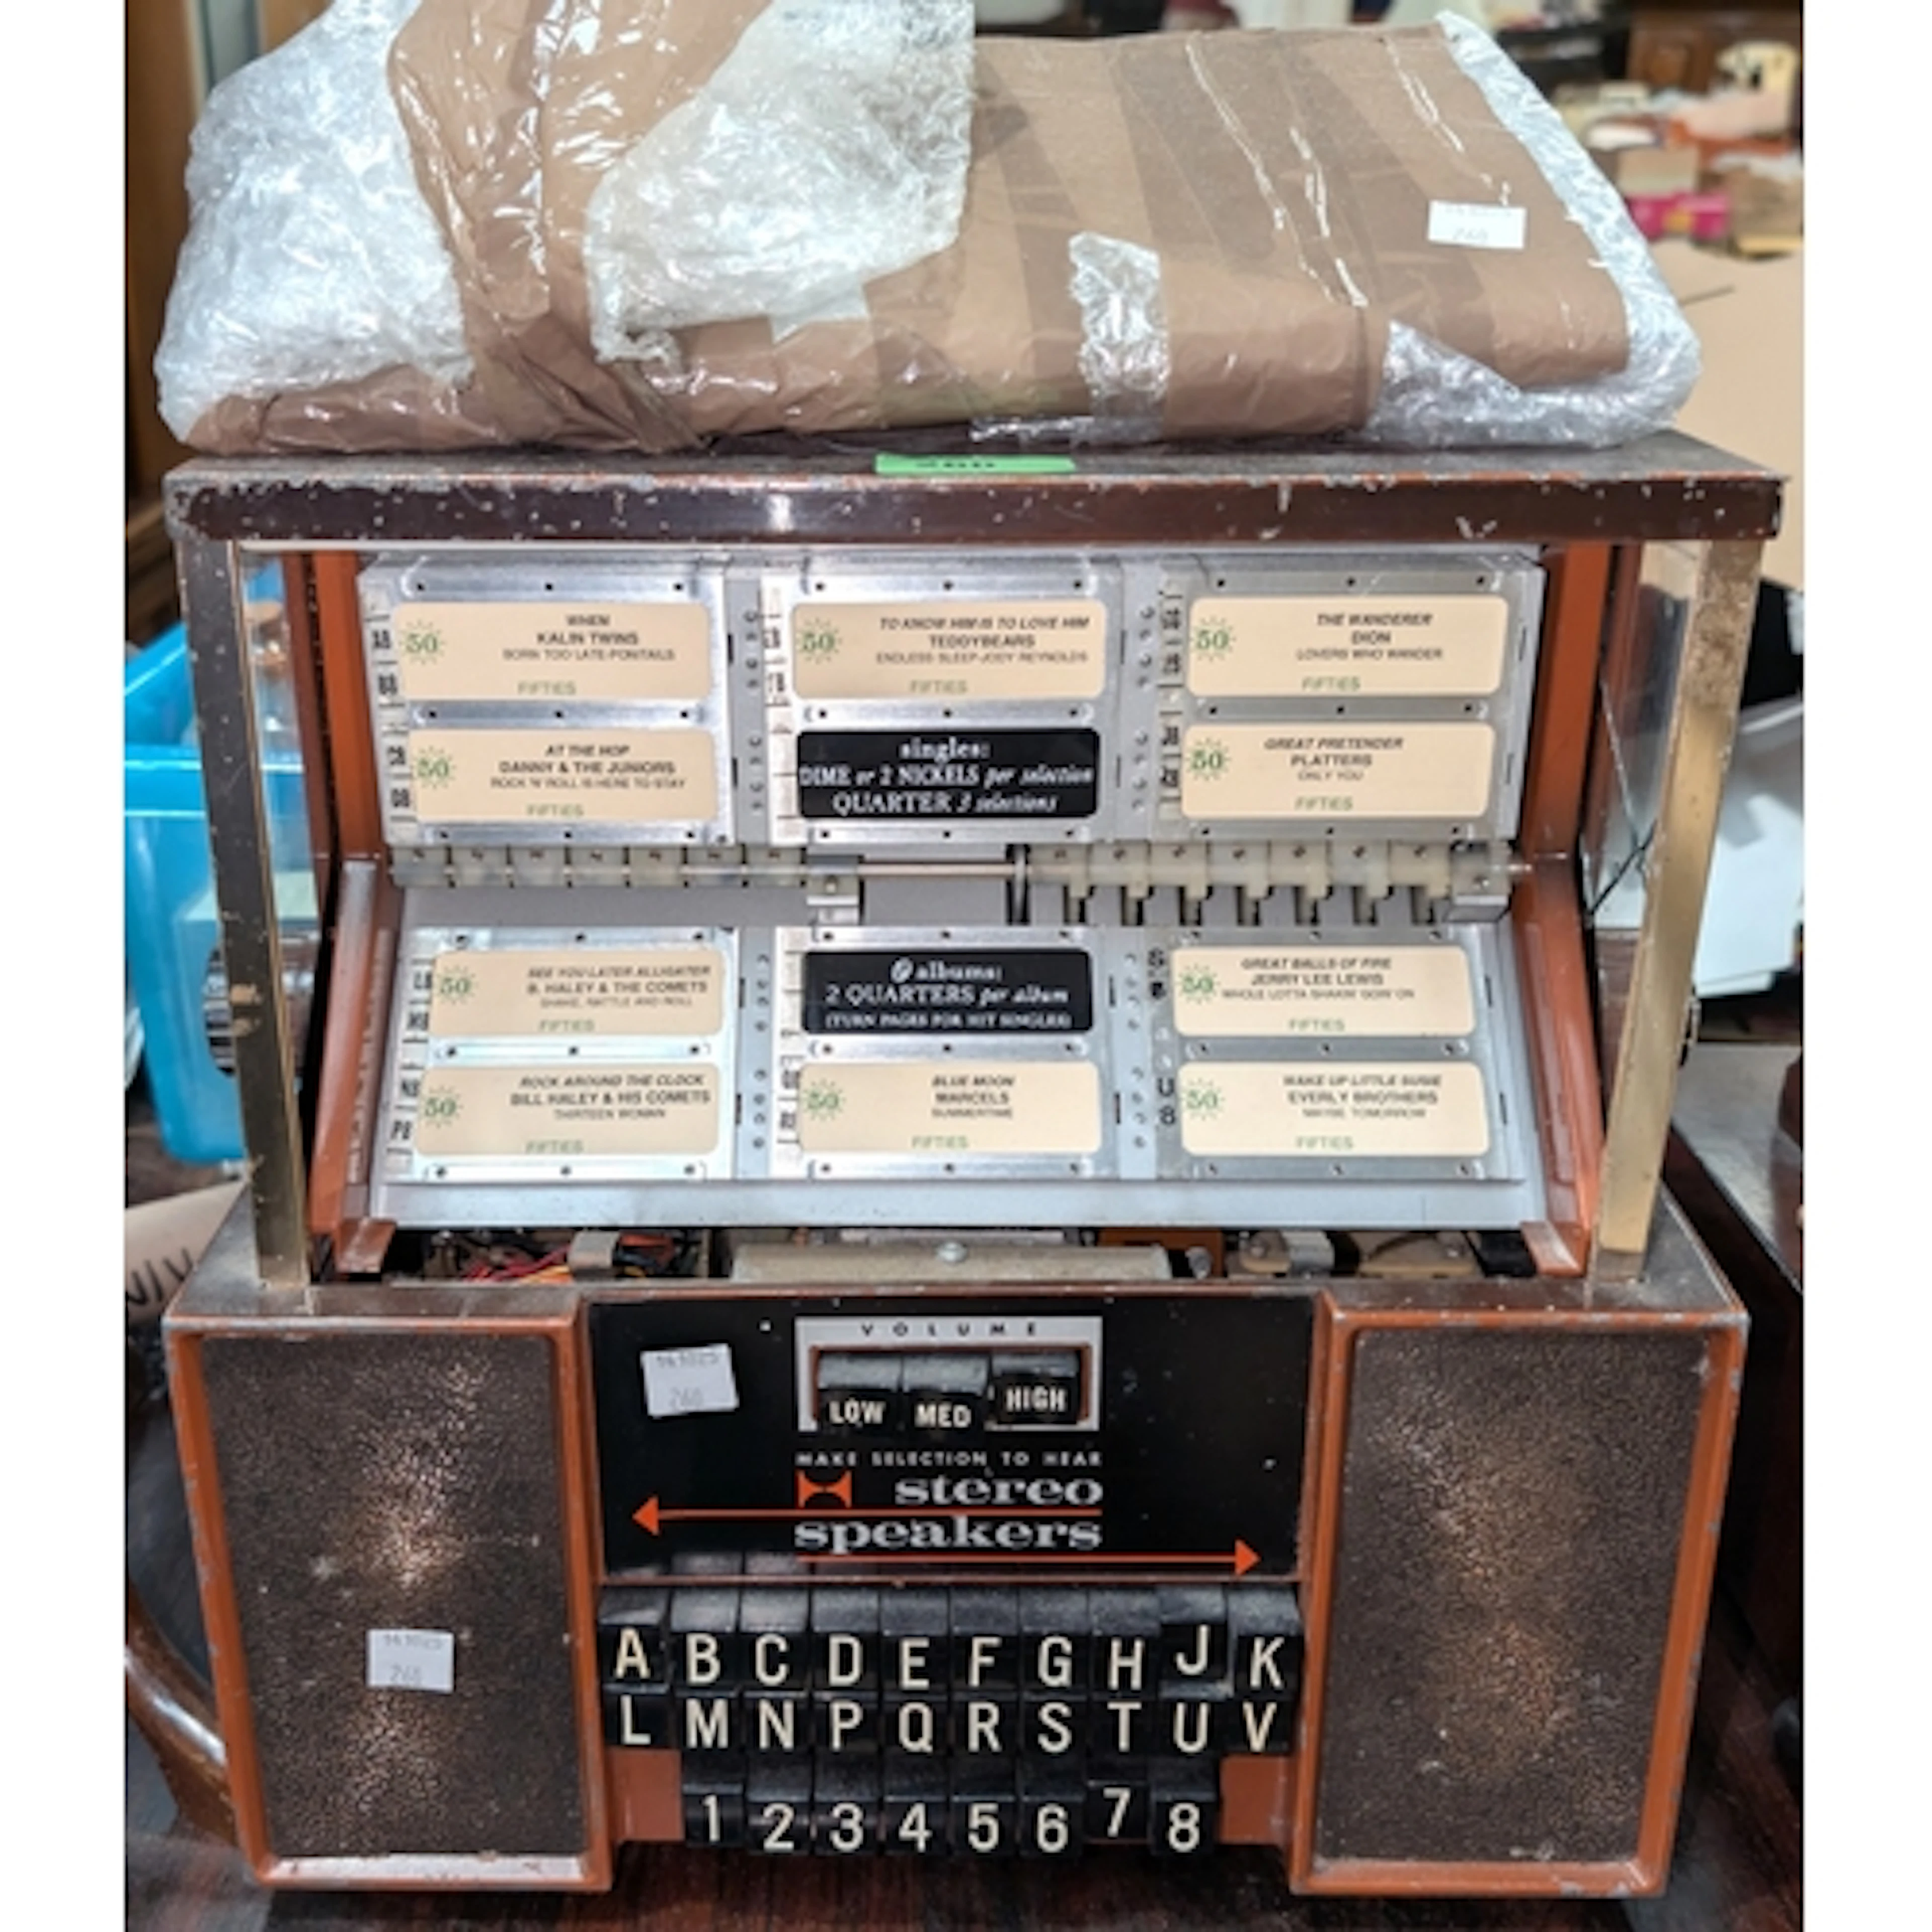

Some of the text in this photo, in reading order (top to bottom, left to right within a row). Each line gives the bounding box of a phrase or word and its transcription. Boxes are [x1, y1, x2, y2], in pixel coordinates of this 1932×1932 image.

[567, 614, 609, 626] WHEN
[880, 618, 1089, 629] TO KNOW HIM IS TO LOVE HIM
[1318, 614, 1432, 625] THE WANDERER
[406, 633, 437, 654] 50
[538, 633, 638, 645] KALIN TWINS
[804, 633, 835, 651] 50
[928, 634, 1035, 647] TEDDYBEARS
[1197, 630, 1229, 649] 50
[1352, 631, 1391, 643] DION
[503, 650, 571, 660] BORN TOO
[877, 653, 1087, 663] ENDLESS REYNOLDS
[1296, 650, 1442, 660] LOVERS WHO WANDER
[518, 682, 576, 695] FIFTIES
[910, 680, 967, 693] FIFTIES
[1302, 677, 1360, 690] FIFTIES
[1264, 738, 1403, 749] GREAT PRETENDER
[546, 745, 629, 756] AT THE HOP
[500, 761, 676, 773] DANNY & THE JUNIORS
[1192, 751, 1223, 770] 50
[1291, 755, 1373, 766] PLATTERS
[418, 760, 449, 778] 50
[1298, 770, 1362, 780] ONLY YOU
[492, 777, 525, 788] ROCK
[546, 777, 576, 788] ROLL
[598, 777, 629, 788] HERE
[654, 777, 686, 788] STAY
[800, 767, 852, 785] DIME
[899, 765, 979, 785] NICKELS
[986, 767, 1017, 788] per
[526, 804, 584, 816] FIFTIES
[833, 793, 951, 815] QUARTER
[1295, 797, 1352, 810] FIFTIES
[1242, 958, 1391, 970] GREAT BALLS OF FIRE
[557, 967, 586, 978] YOU
[591, 967, 631, 978] LATER
[440, 978, 470, 994] 50
[1183, 976, 1214, 993] 50
[1251, 974, 1383, 986] JERRY LEE LEWIS
[545, 983, 707, 993] HALEY & THE COMETS
[1222, 990, 1414, 999] WHOLE LOTTA ON
[825, 984, 1068, 1007] 2 QUARTERS per album
[540, 1020, 595, 1031] FIFTIES
[1289, 1019, 1345, 1031] FIFTIES
[519, 1075, 703, 1088] ROCK AROUND THE CLOCK
[932, 1076, 1015, 1087] BLUE MOON
[1284, 1076, 1323, 1086] WAKE
[1329, 1076, 1348, 1086] UP
[1352, 1076, 1396, 1086] LITTLE
[510, 1090, 710, 1106] BILL HALEY & HIS COMETS
[806, 1091, 838, 1110] 50
[935, 1093, 1009, 1104] MARCELS
[1187, 1090, 1218, 1109] 50
[1288, 1092, 1438, 1104] EVERLY BROTHERS
[425, 1098, 456, 1116] 50
[525, 1140, 584, 1153] FIFTIES
[912, 1136, 968, 1148] FIFTIES
[1296, 1136, 1353, 1149] FIFTIES
[861, 1323, 1036, 1336] VOLUME
[829, 1386, 1067, 1428] LOW MED HIGH
[796, 1452, 1101, 1466] MAKE SELECTION TO HEAR
[895, 1475, 1102, 1505] stereo
[794, 1515, 1101, 1555] speakers
[616, 1625, 1284, 1690] A B C D E F G H J K
[621, 1695, 1277, 1753] L M N P Q R S T U V
[702, 1788, 1200, 1853] 1 2 3 4 5 6 7 8
